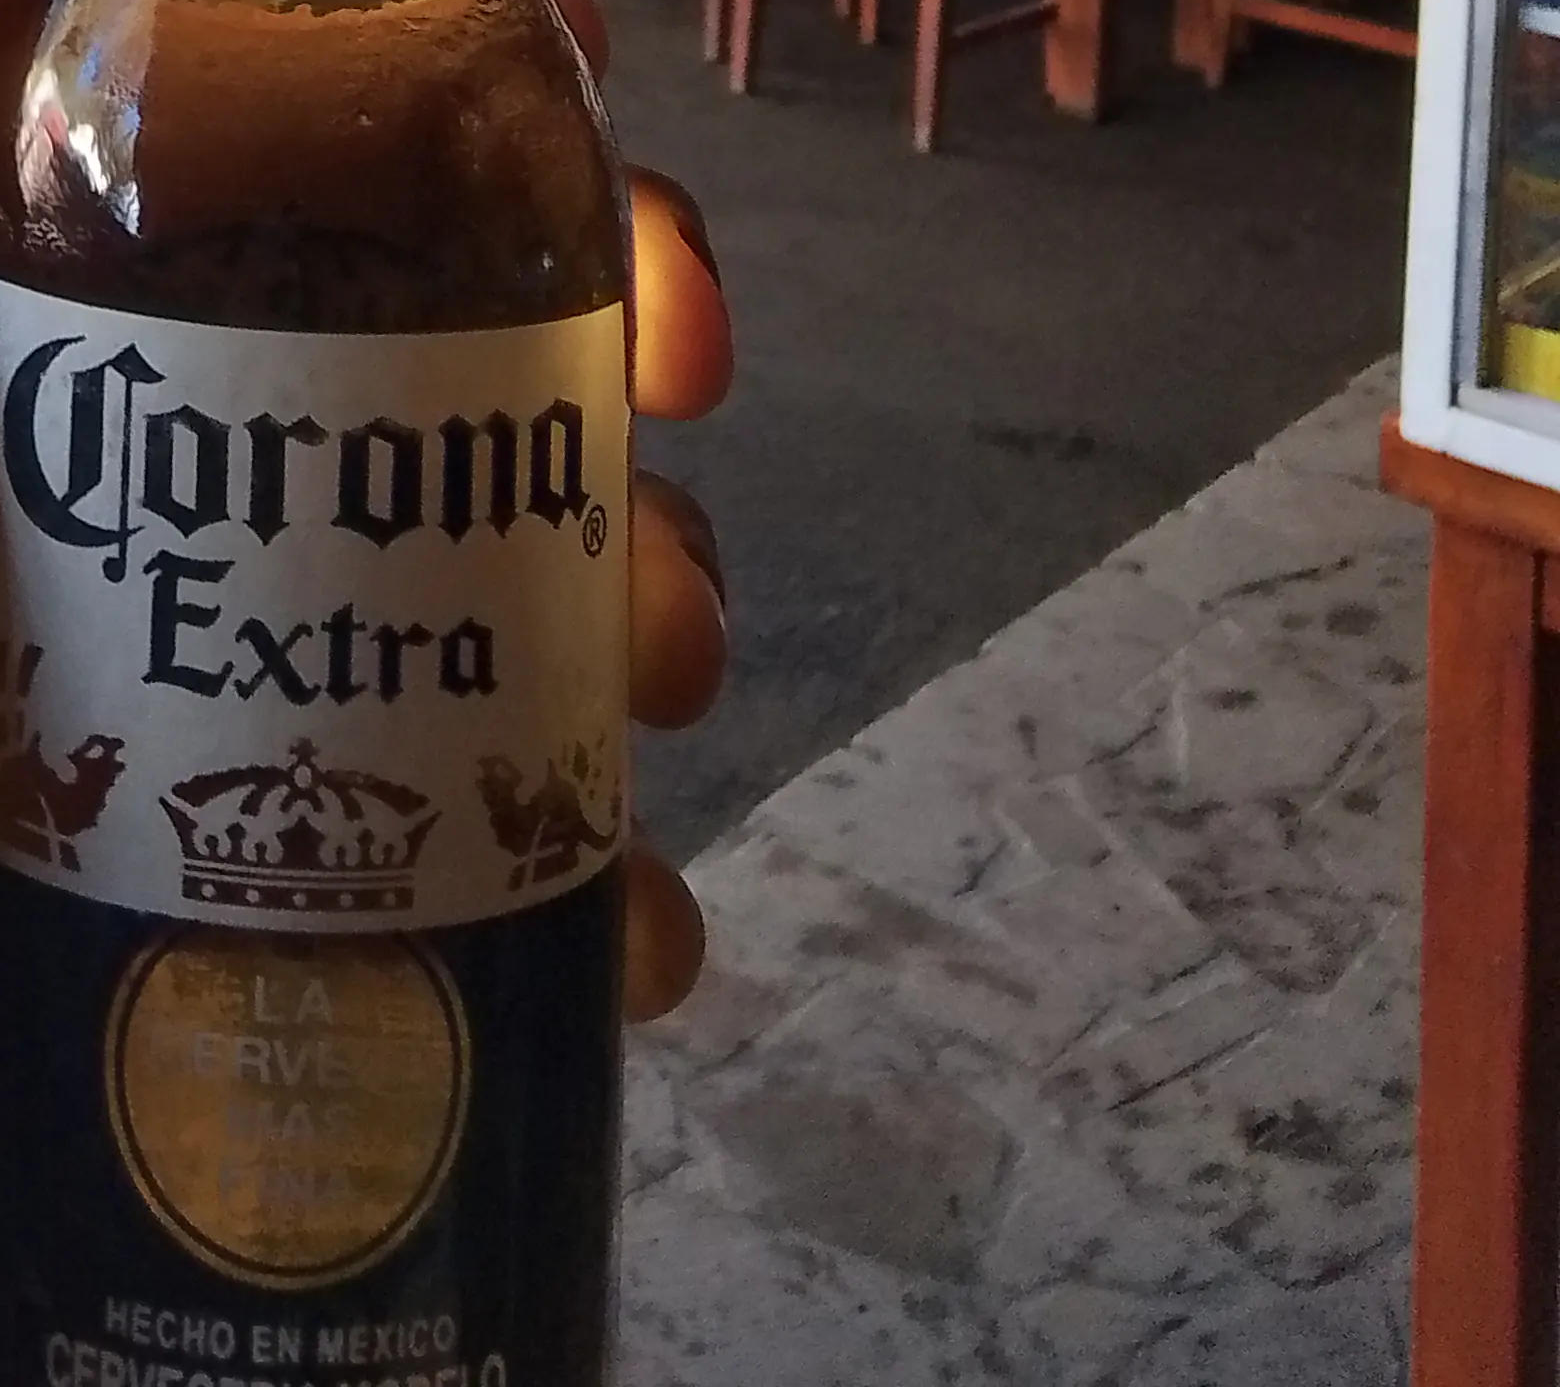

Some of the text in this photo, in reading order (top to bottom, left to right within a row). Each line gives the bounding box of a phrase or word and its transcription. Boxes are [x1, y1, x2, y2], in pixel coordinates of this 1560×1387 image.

[142, 549, 499, 707] Extra
[254, 975, 333, 1025] LA
[105, 1296, 236, 1359] HECHO
[252, 1325, 301, 1364] EN
